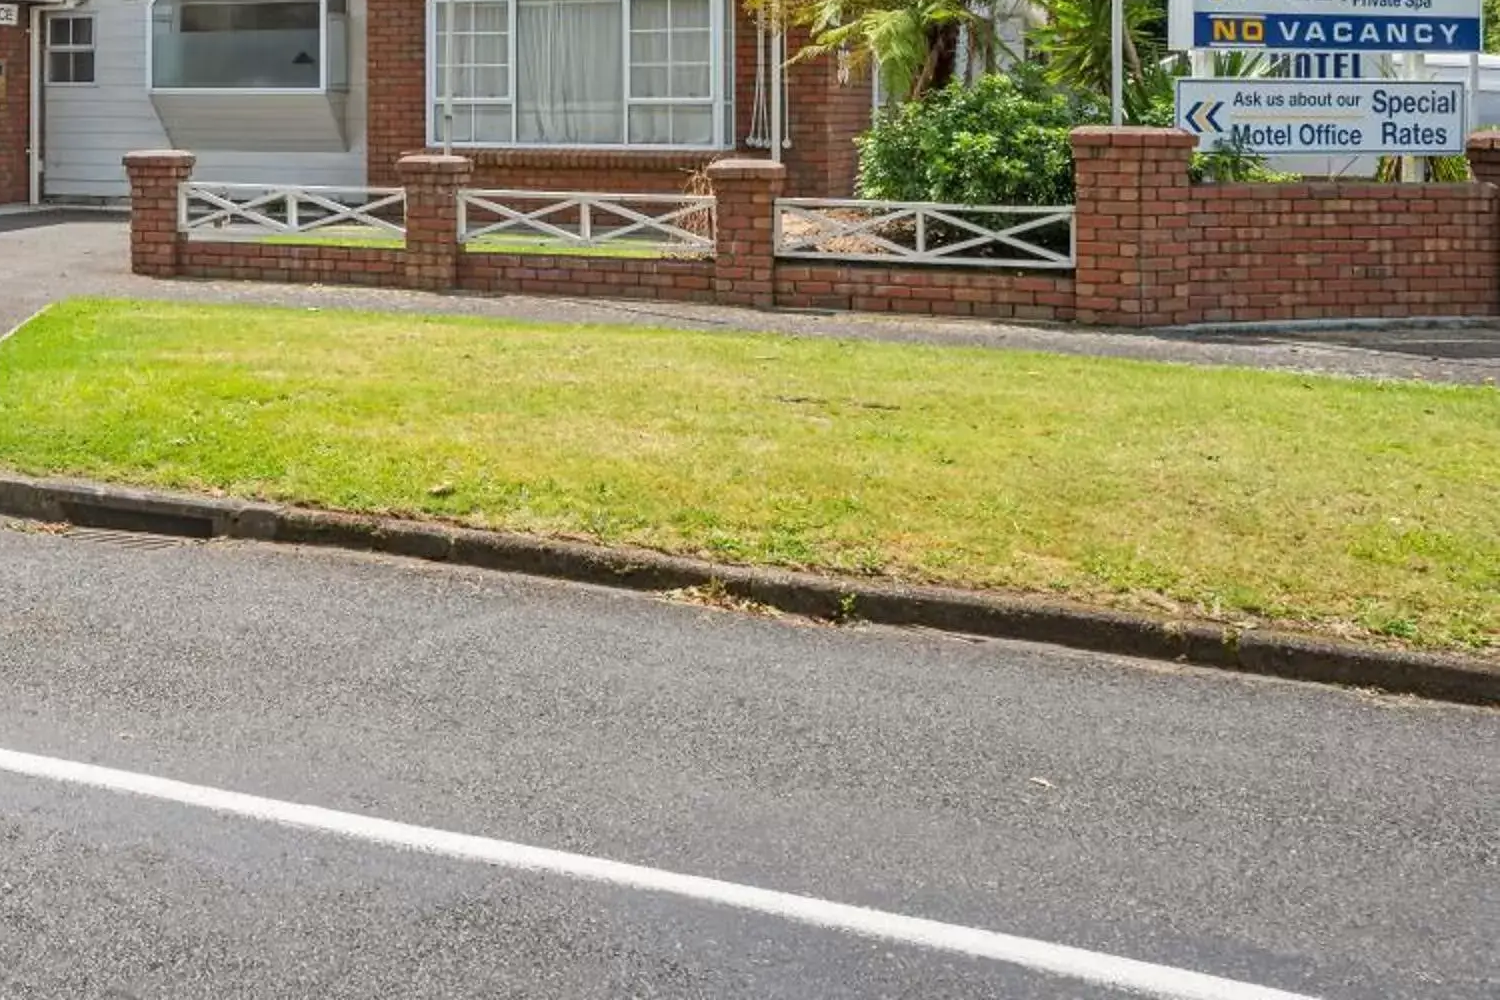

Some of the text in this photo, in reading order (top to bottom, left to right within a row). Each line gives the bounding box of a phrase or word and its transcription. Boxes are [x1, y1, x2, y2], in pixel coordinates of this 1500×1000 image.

[1212, 20, 1459, 44] NO VACANCY
[1233, 91, 1362, 108] Ask us about our
[1372, 89, 1457, 119] Special
[1232, 124, 1363, 146] Motel Office
[1381, 122, 1448, 145] Rates
